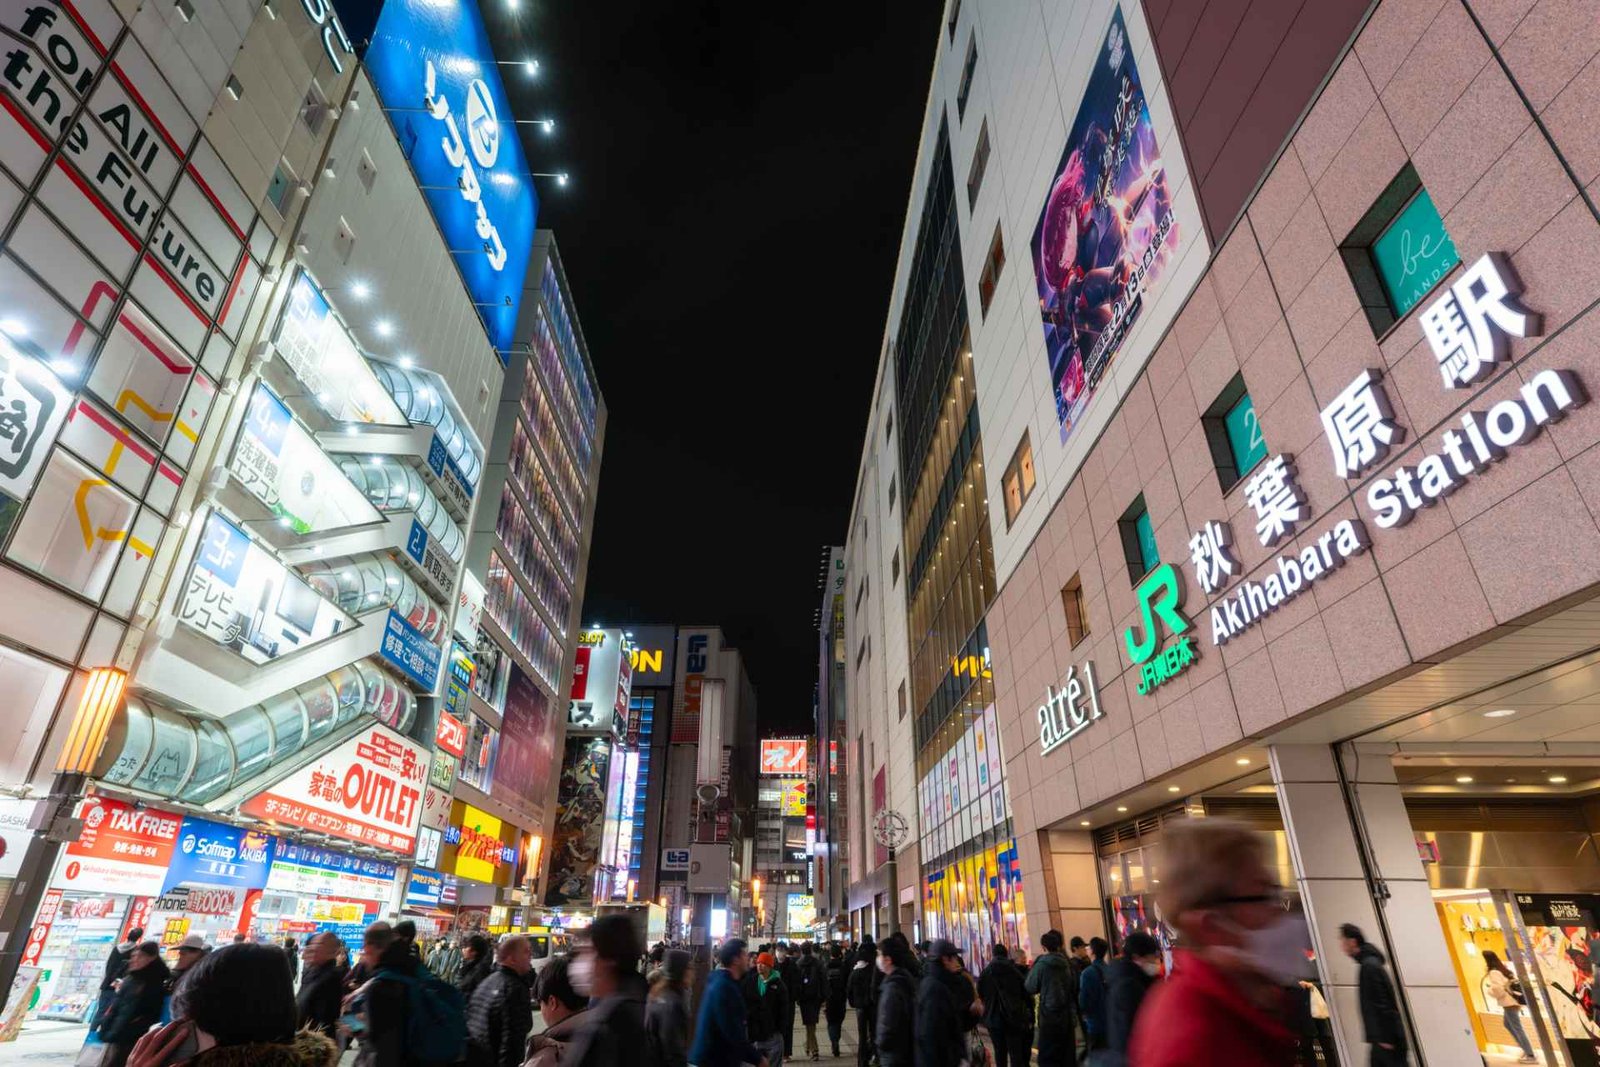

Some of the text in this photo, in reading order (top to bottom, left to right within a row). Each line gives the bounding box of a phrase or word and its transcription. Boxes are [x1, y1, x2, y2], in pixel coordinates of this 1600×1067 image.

[99, 103, 159, 173] All
[3, 49, 215, 302] the Future
[1402, 259, 1450, 308] HANDS
[1189, 252, 1528, 594] 秋葉原駅
[232, 457, 280, 506] エアコン
[1211, 369, 1573, 645] Akihabara Station
[207, 525, 236, 570] 3F
[190, 573, 235, 615] テレビ
[1124, 562, 1189, 665] JR
[181, 598, 251, 645] レコーダー
[579, 631, 605, 643] SLOT
[1136, 636, 1196, 696] JR東日本
[438, 717, 463, 752] アコム
[109, 808, 177, 839] TAX FREE
[195, 837, 268, 865] Sofmap AKIBA
